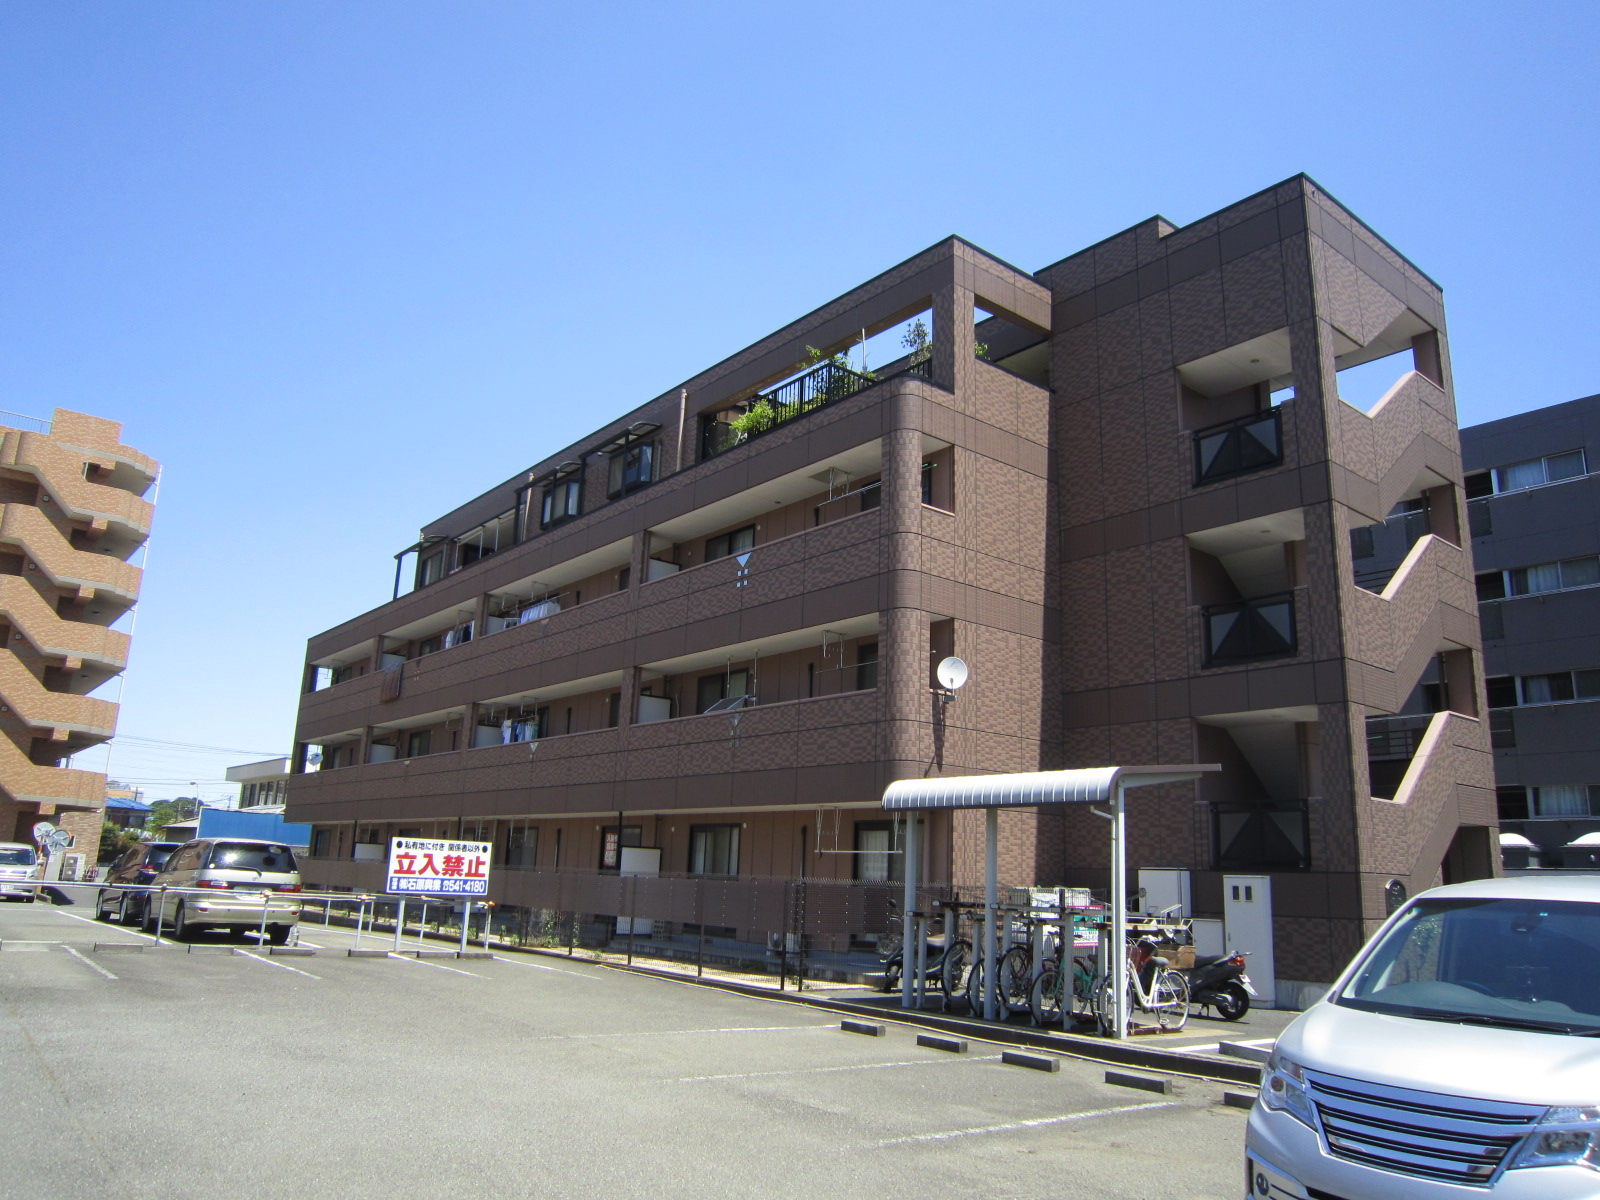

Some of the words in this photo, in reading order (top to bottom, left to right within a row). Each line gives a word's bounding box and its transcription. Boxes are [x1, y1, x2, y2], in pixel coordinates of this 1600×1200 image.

[404, 840, 445, 851] 私有地に付き
[448, 843, 481, 853] 関係者以外
[393, 852, 486, 878] 立入禁止
